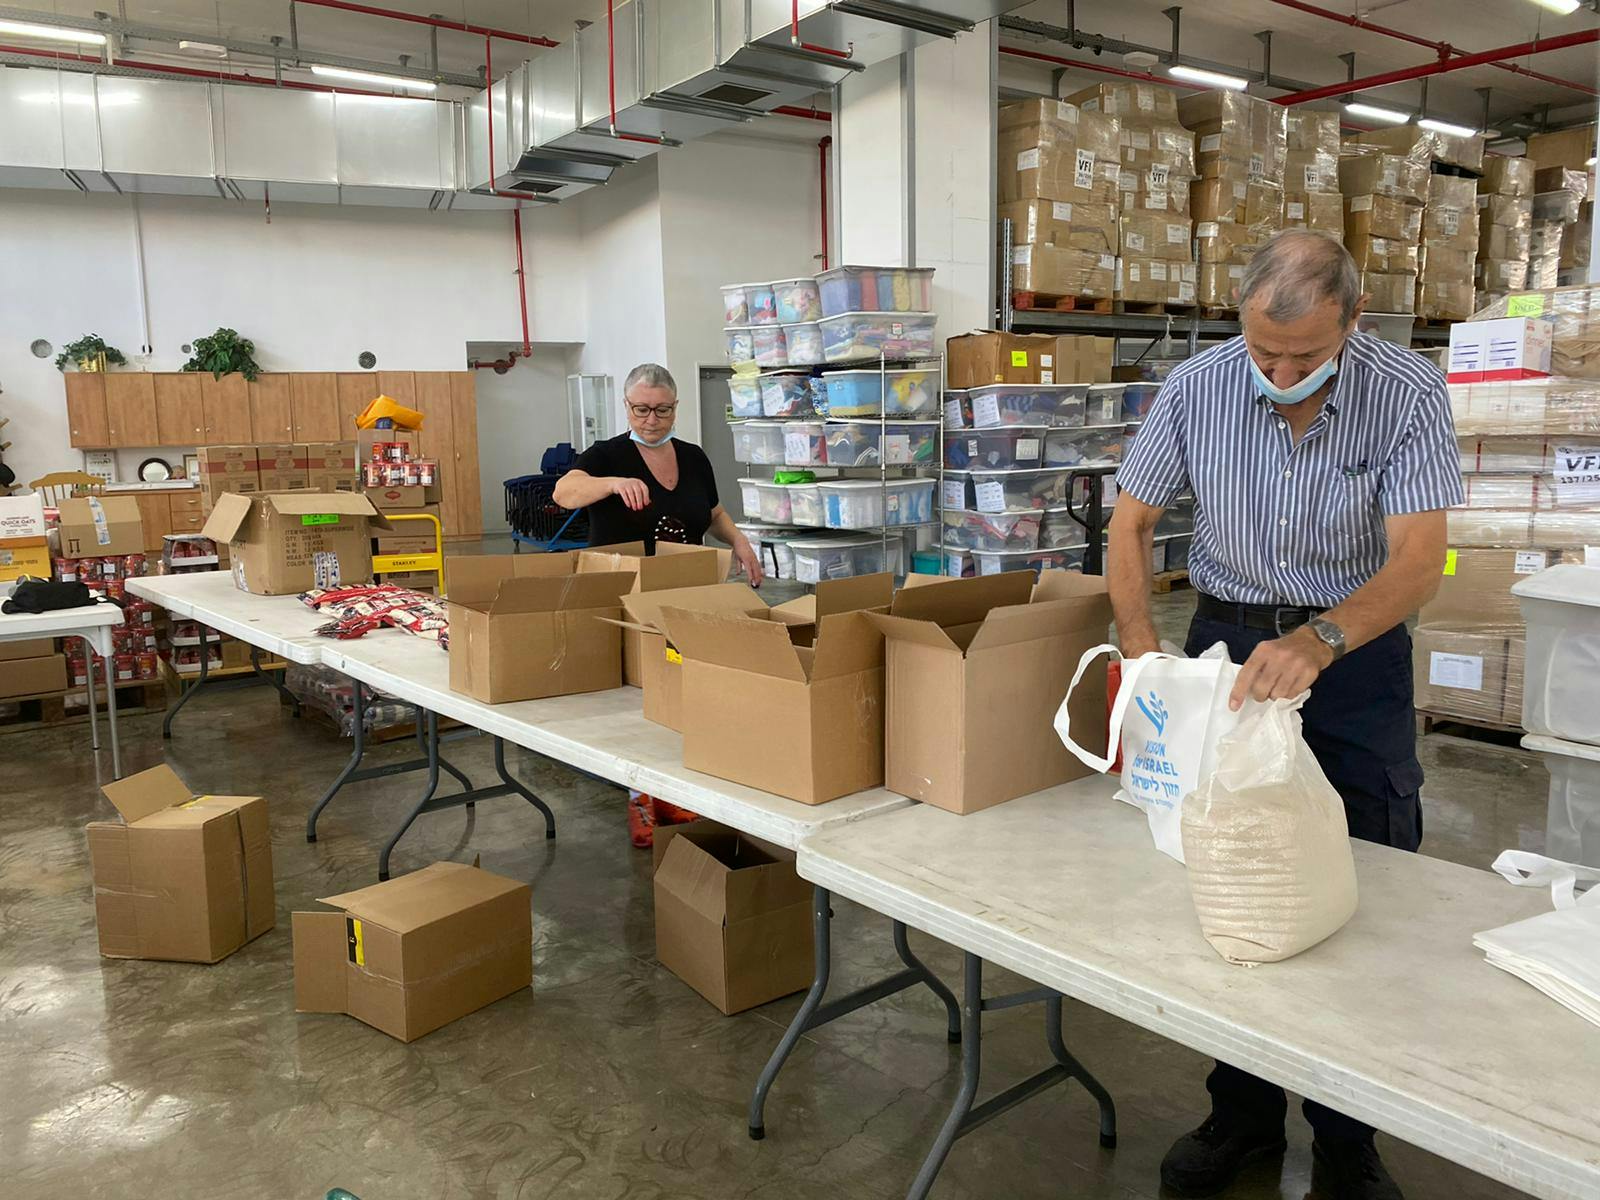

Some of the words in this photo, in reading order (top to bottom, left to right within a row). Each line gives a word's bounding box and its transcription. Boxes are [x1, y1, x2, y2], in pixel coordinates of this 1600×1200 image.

[1078, 159, 1092, 173] VFI
[1152, 172, 1165, 183] VFI
[1145, 740, 1167, 757] VISION
